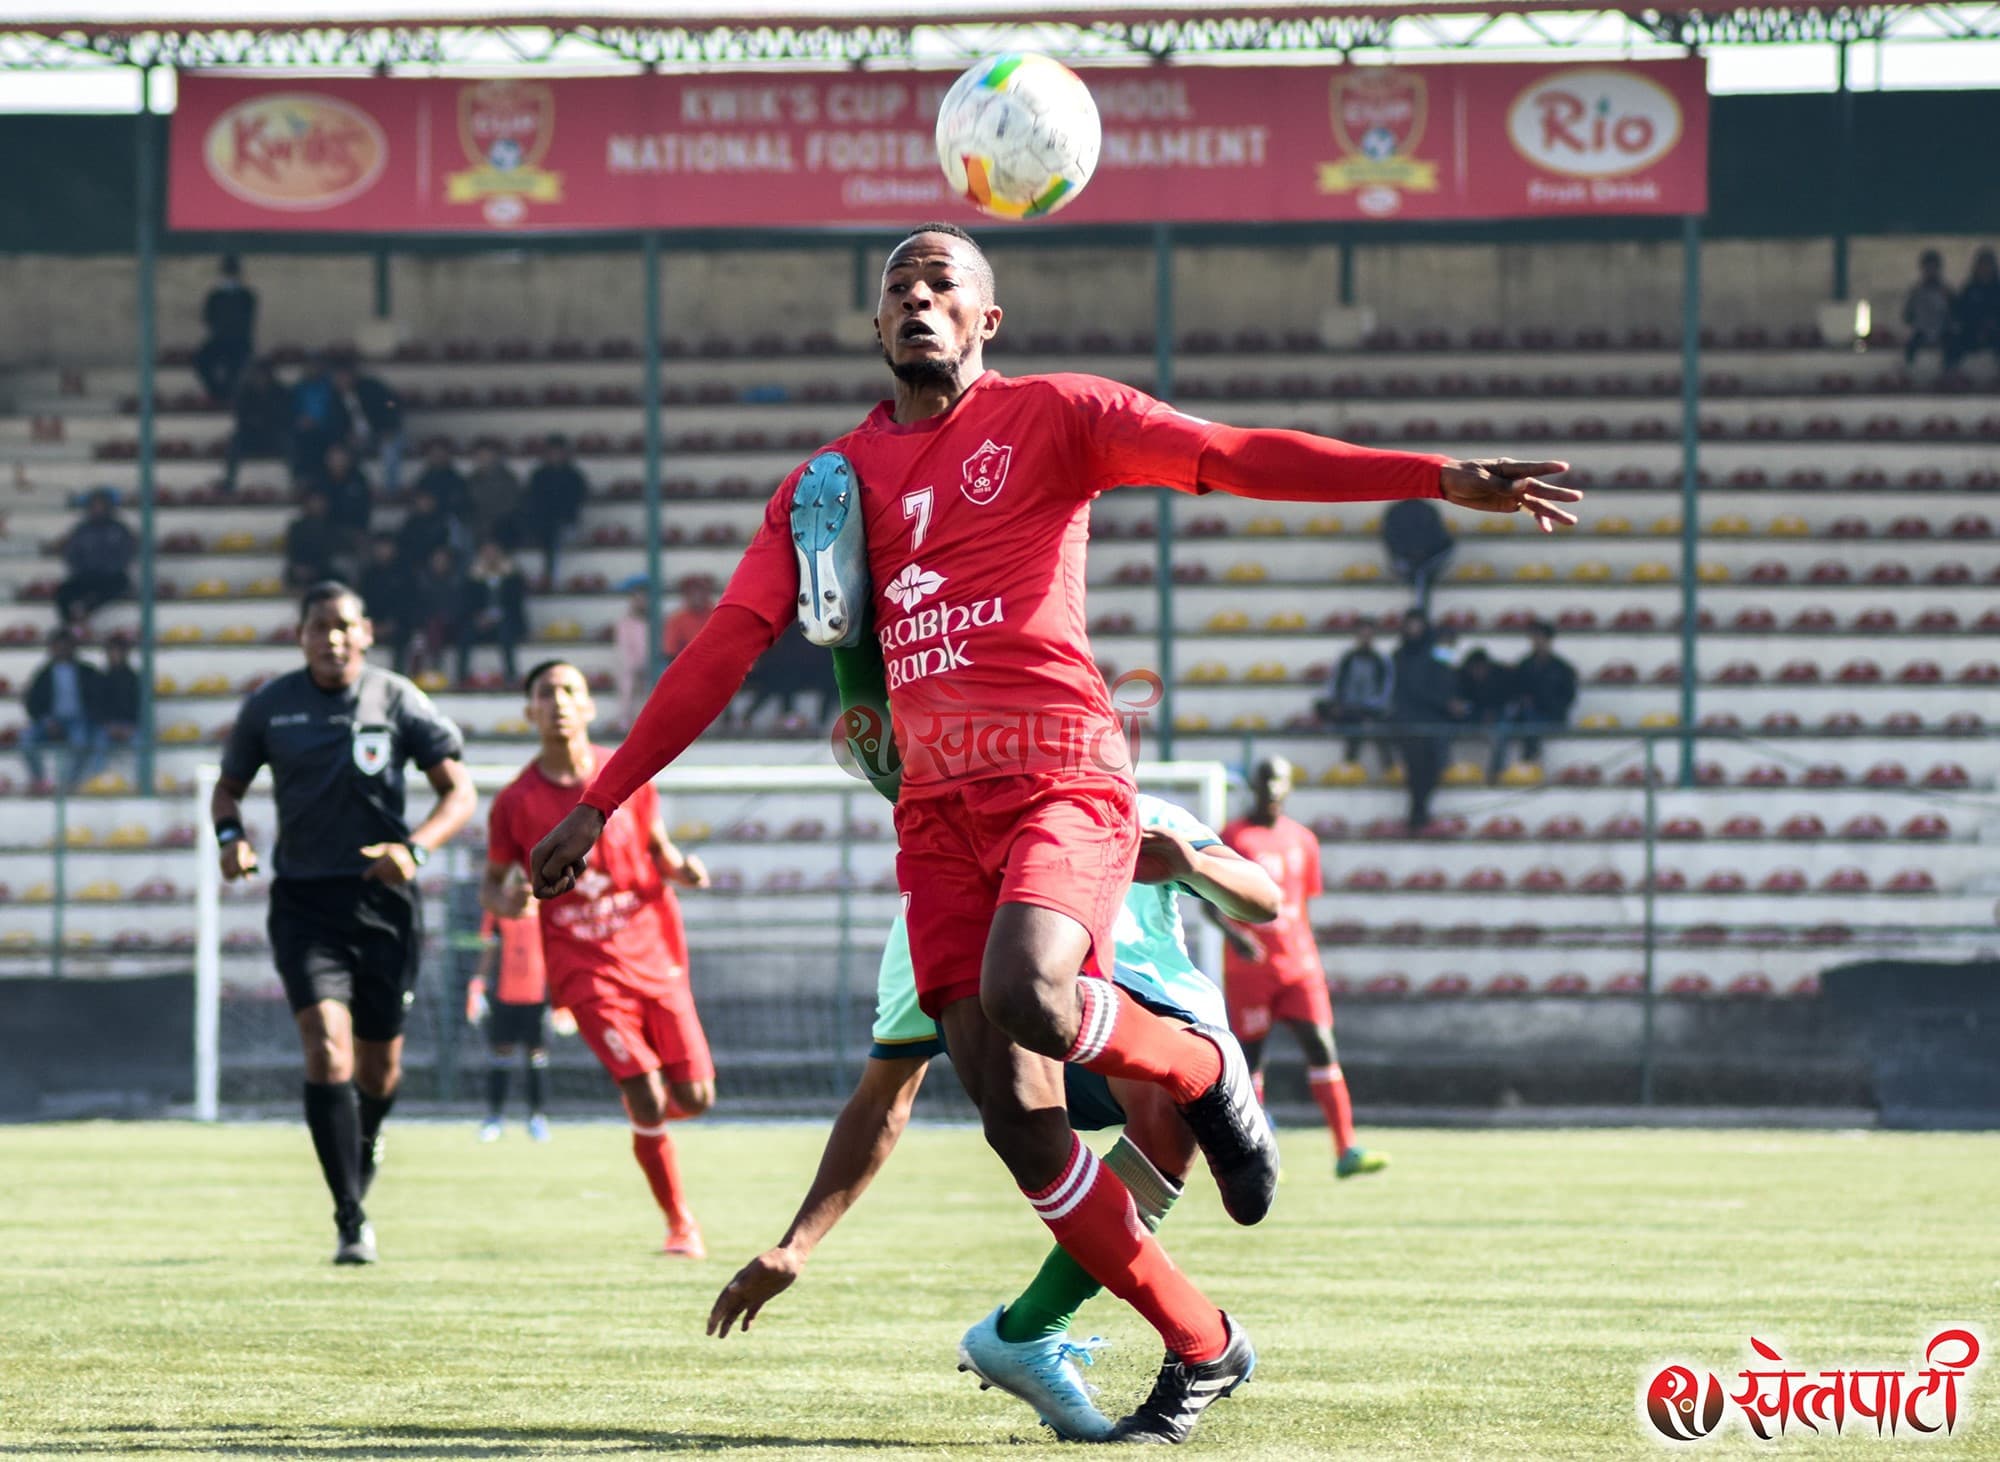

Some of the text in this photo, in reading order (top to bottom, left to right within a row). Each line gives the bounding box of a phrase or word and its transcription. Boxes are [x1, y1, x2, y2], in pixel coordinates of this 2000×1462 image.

[682, 85, 818, 123] KWIK'S
[826, 83, 906, 121] CUP
[1088, 81, 1194, 119] HOOL
[1535, 88, 1655, 155] Rio
[607, 131, 796, 173] NATIONAL
[805, 131, 941, 171] FOOTBA
[1100, 127, 1270, 168] NAMENT
[902, 486, 934, 552] 7
